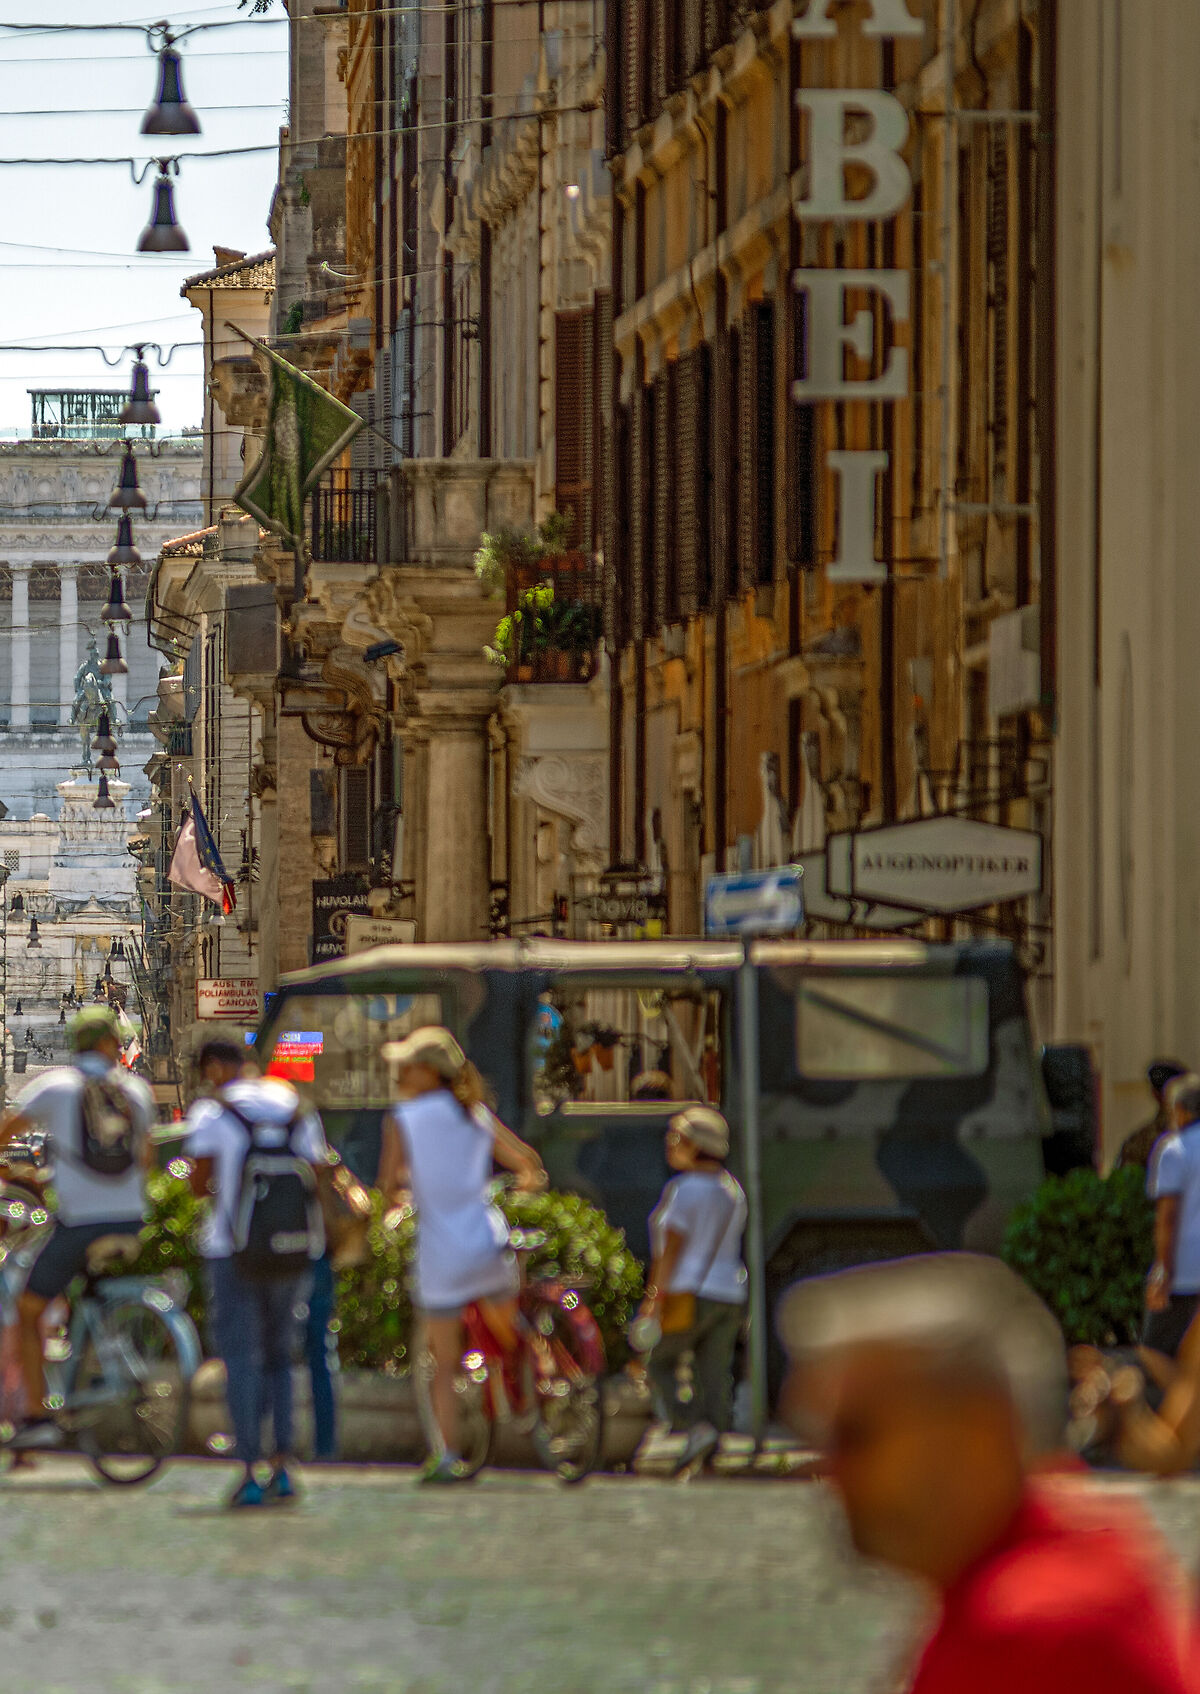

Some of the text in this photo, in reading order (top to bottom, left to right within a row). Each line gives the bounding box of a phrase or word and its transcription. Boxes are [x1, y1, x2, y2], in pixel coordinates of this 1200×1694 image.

[792, 0, 924, 583] BEI
[862, 853, 1030, 874] AUGENOPTIKER
[316, 894, 368, 908] NUVOLAR
[213, 980, 236, 988] AUSL
[218, 998, 258, 1007] CANOVA
